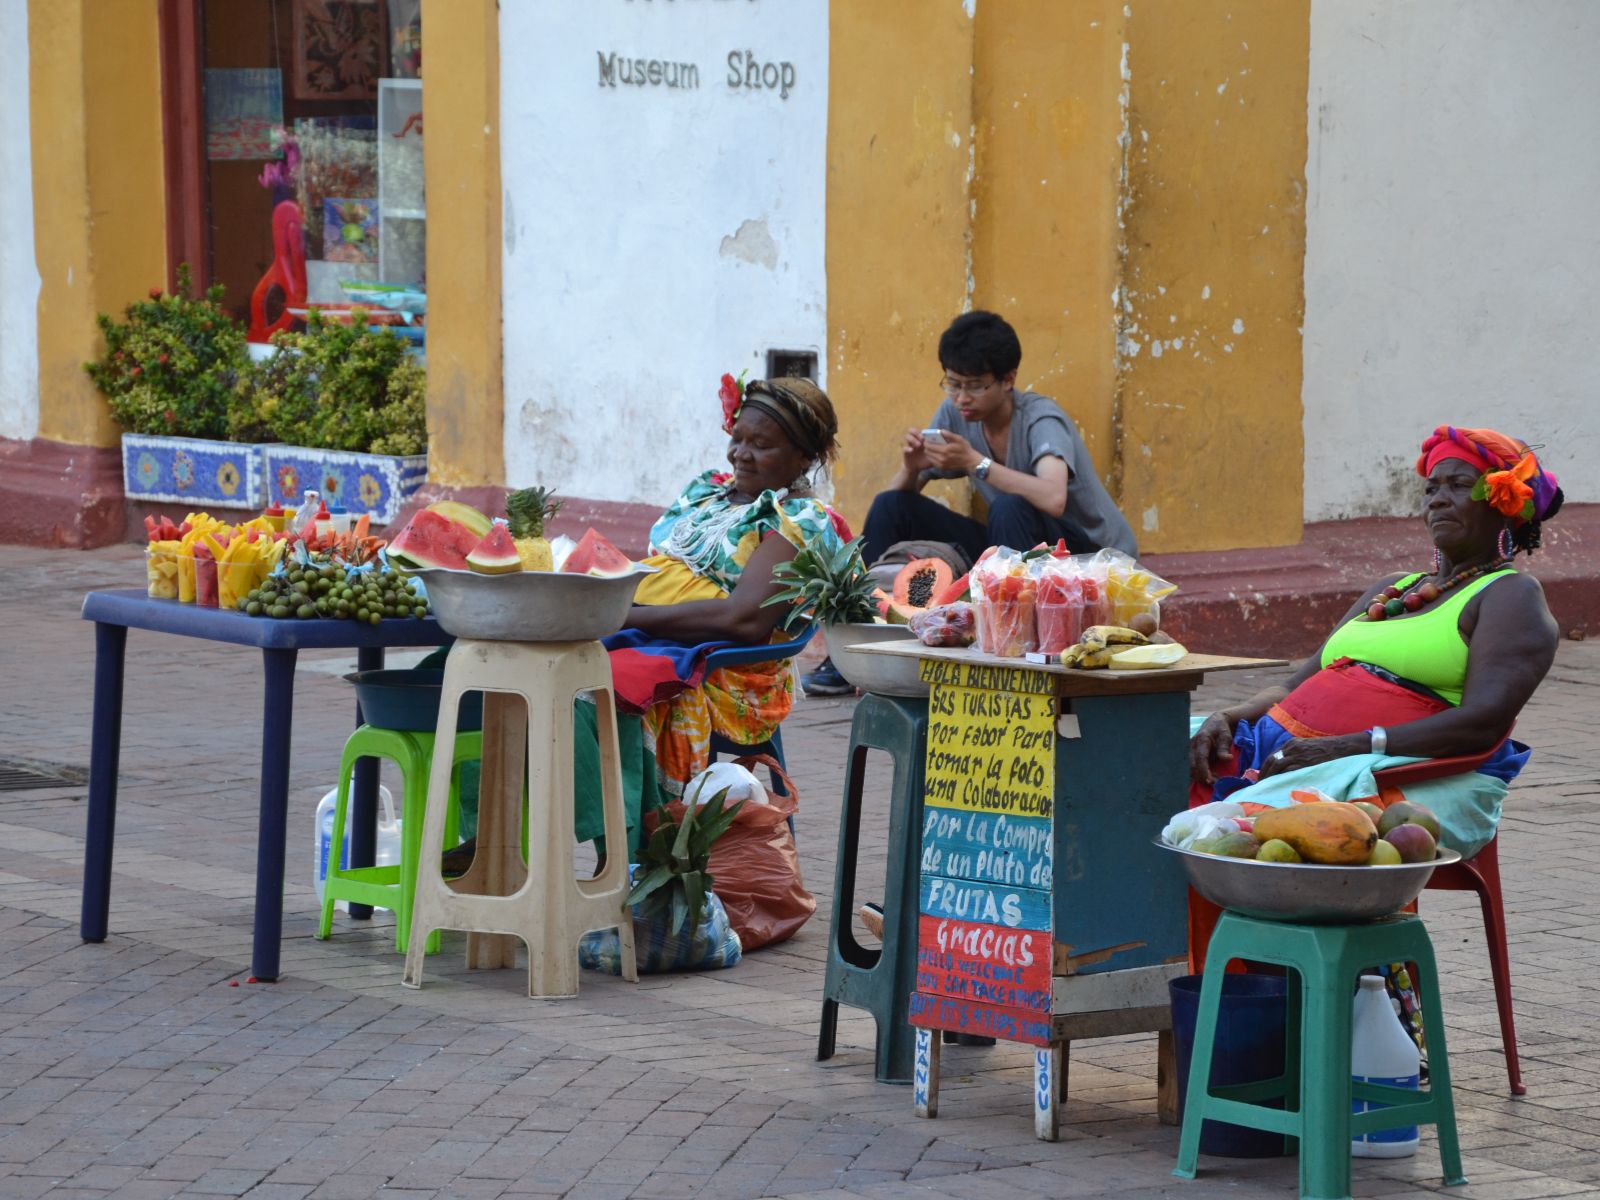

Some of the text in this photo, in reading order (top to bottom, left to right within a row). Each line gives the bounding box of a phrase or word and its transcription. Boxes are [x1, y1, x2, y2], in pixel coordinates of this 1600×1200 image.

[597, 50, 795, 100] Museum Shop
[921, 659, 960, 685] HOLA
[963, 692, 1031, 720] TURISTAS
[928, 747, 982, 776] tomar
[925, 777, 957, 802] una
[922, 840, 941, 872] de
[947, 852, 970, 877] un
[926, 879, 1023, 927] FRUTAS
[918, 948, 1025, 985] HELLO WELCOME
[918, 973, 938, 990] YOU
[945, 974, 968, 994] CAN
[972, 980, 1006, 1005] TAKE
[915, 1030, 928, 1105] THANK
